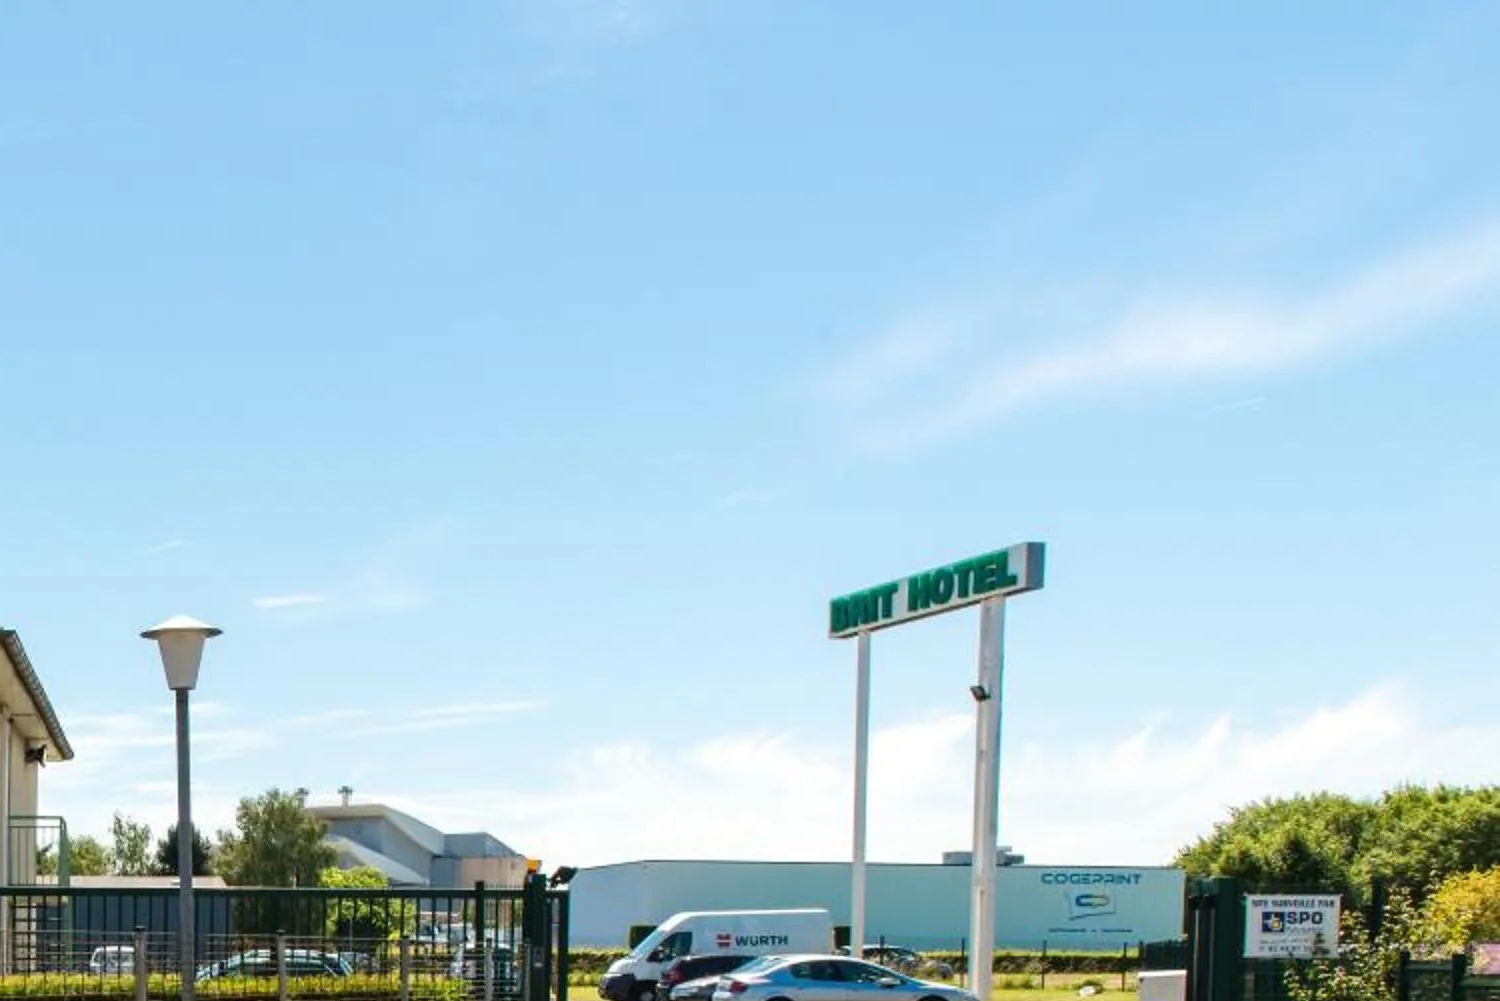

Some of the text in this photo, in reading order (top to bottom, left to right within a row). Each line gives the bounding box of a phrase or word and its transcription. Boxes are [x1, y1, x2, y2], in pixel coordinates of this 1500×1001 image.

[907, 548, 1017, 612] HOTEL
[1041, 873, 1142, 884] COGEPRINT
[1287, 911, 1323, 925] SPO
